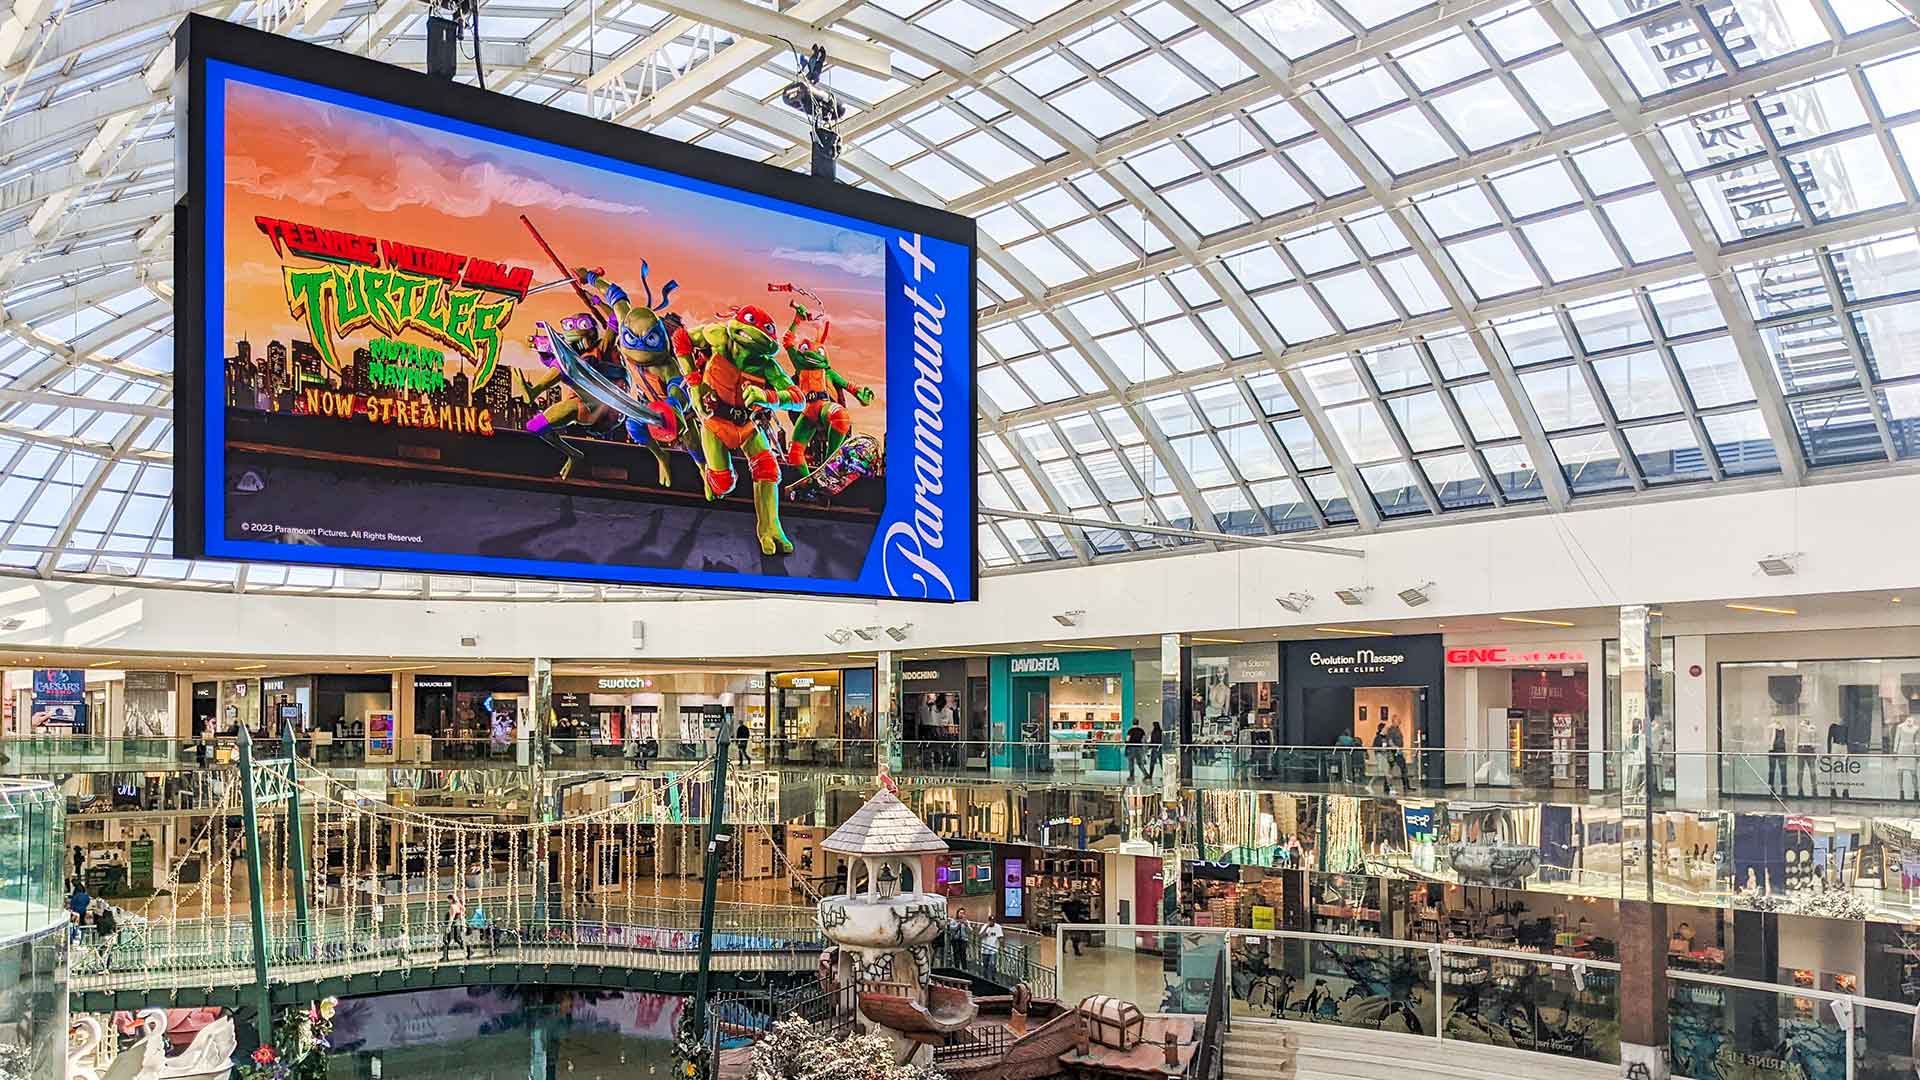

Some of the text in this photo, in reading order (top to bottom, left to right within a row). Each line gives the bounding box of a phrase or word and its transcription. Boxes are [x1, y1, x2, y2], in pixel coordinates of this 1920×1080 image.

[255, 216, 534, 302] TEENAGE MUTANT NINJA
[282, 264, 515, 393] TURTLES
[369, 337, 445, 370] MUTANT
[368, 362, 447, 393] MAYHEM
[305, 388, 495, 436] NOW STREAMING
[251, 523, 273, 532] 2023
[275, 525, 317, 536] Paramount
[317, 527, 349, 538] Pictures.
[351, 530, 362, 539] All
[363, 531, 387, 541] Rights
[388, 534, 424, 543] Reserved.
[1447, 648, 1508, 664] GNC
[598, 677, 645, 688] swatch
[902, 671, 937, 680] NDOCHINO
[1820, 756, 1861, 773] Sale
